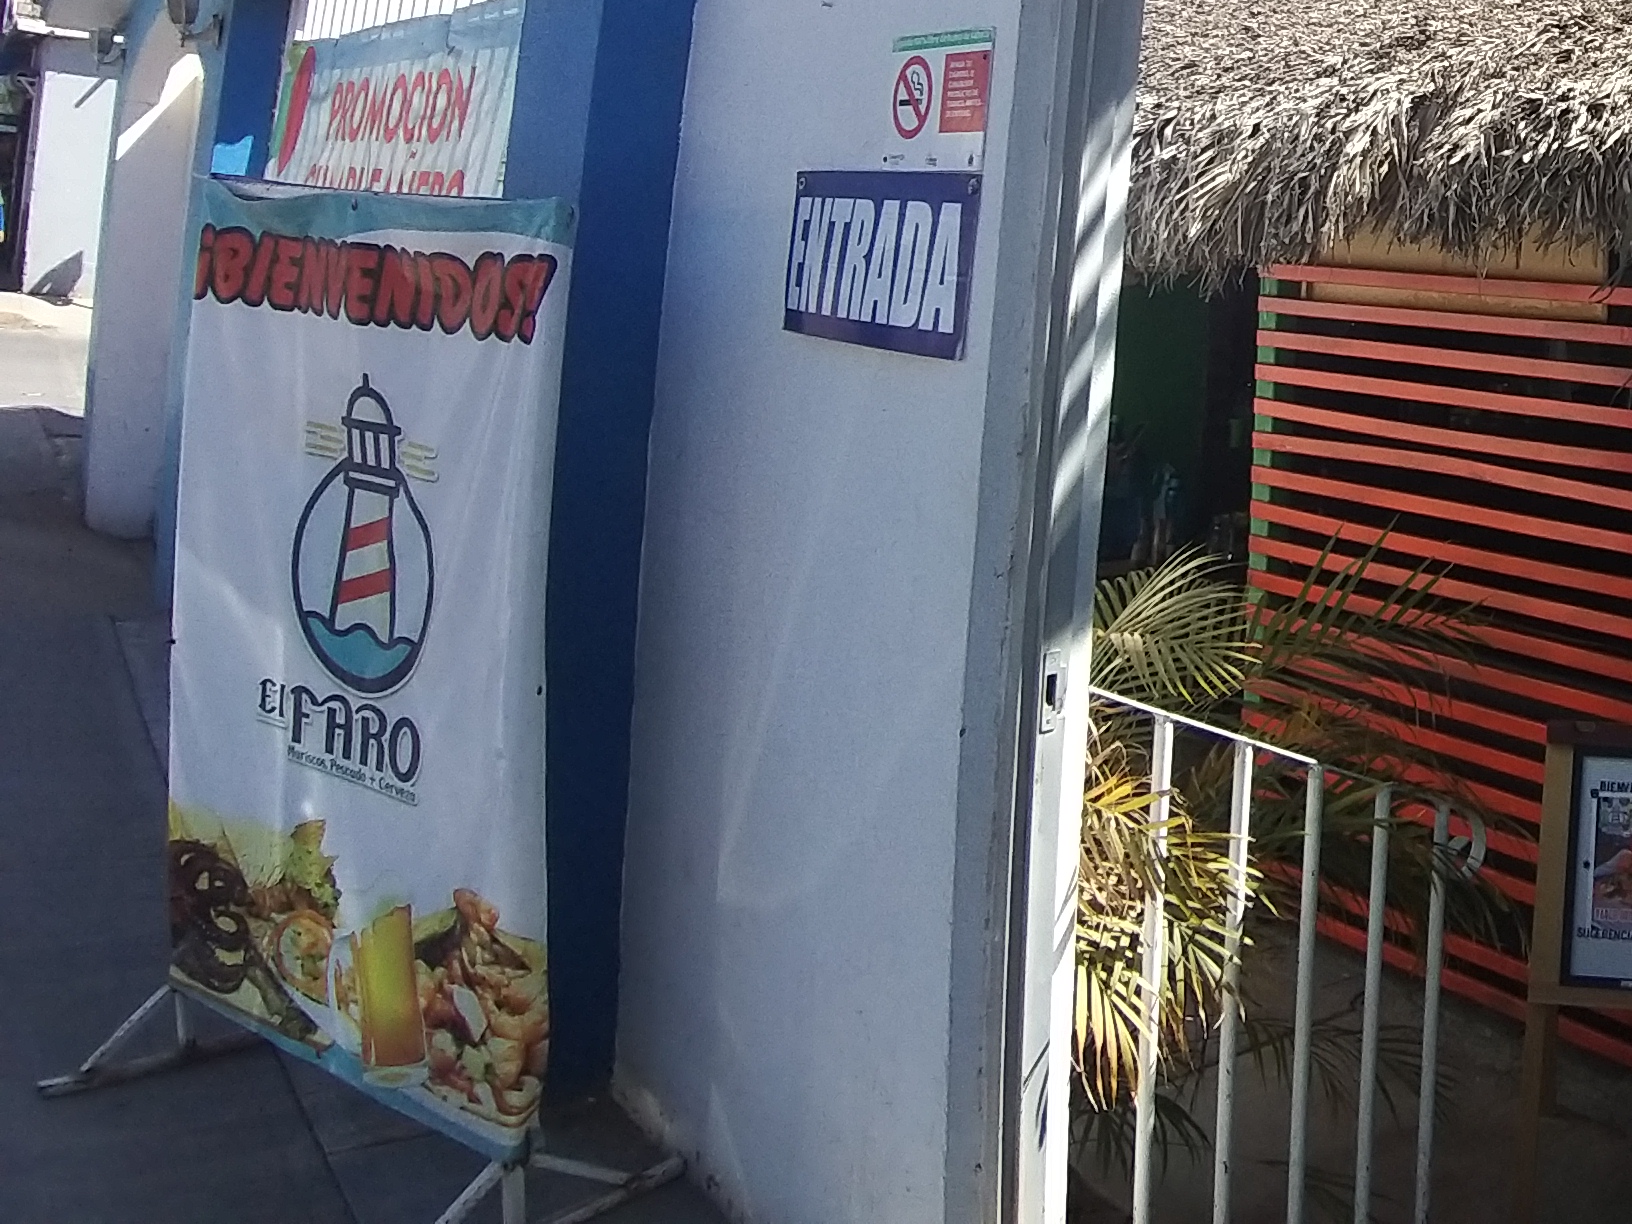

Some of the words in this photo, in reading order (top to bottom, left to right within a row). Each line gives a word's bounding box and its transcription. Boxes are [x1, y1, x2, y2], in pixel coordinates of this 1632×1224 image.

[326, 66, 477, 144] PROMOCION
[193, 222, 558, 345] ¡BIENVENIDOS!
[786, 196, 963, 335] ENTRADA
[290, 684, 421, 784] FARO
